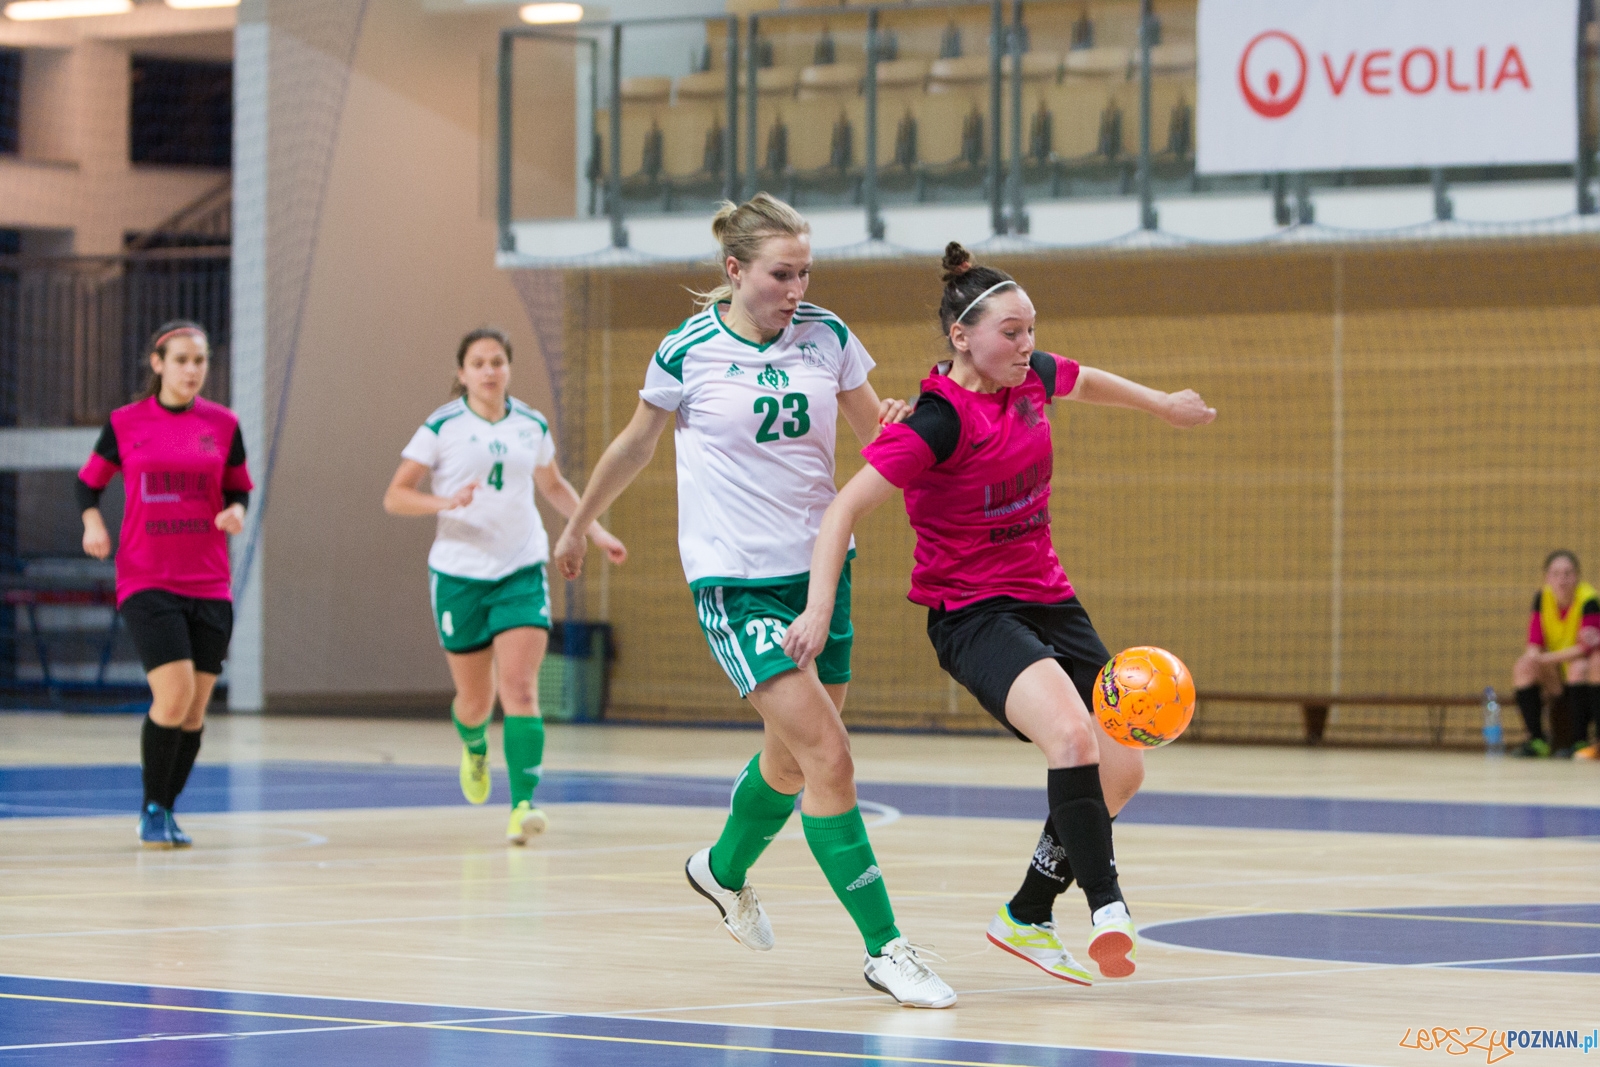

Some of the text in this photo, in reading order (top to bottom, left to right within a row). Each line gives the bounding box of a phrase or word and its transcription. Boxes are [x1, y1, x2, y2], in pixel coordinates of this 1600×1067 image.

[1321, 45, 1532, 97] VEOLIA
[753, 392, 811, 444] 23
[487, 460, 504, 491] 4
[745, 617, 787, 656] 23
